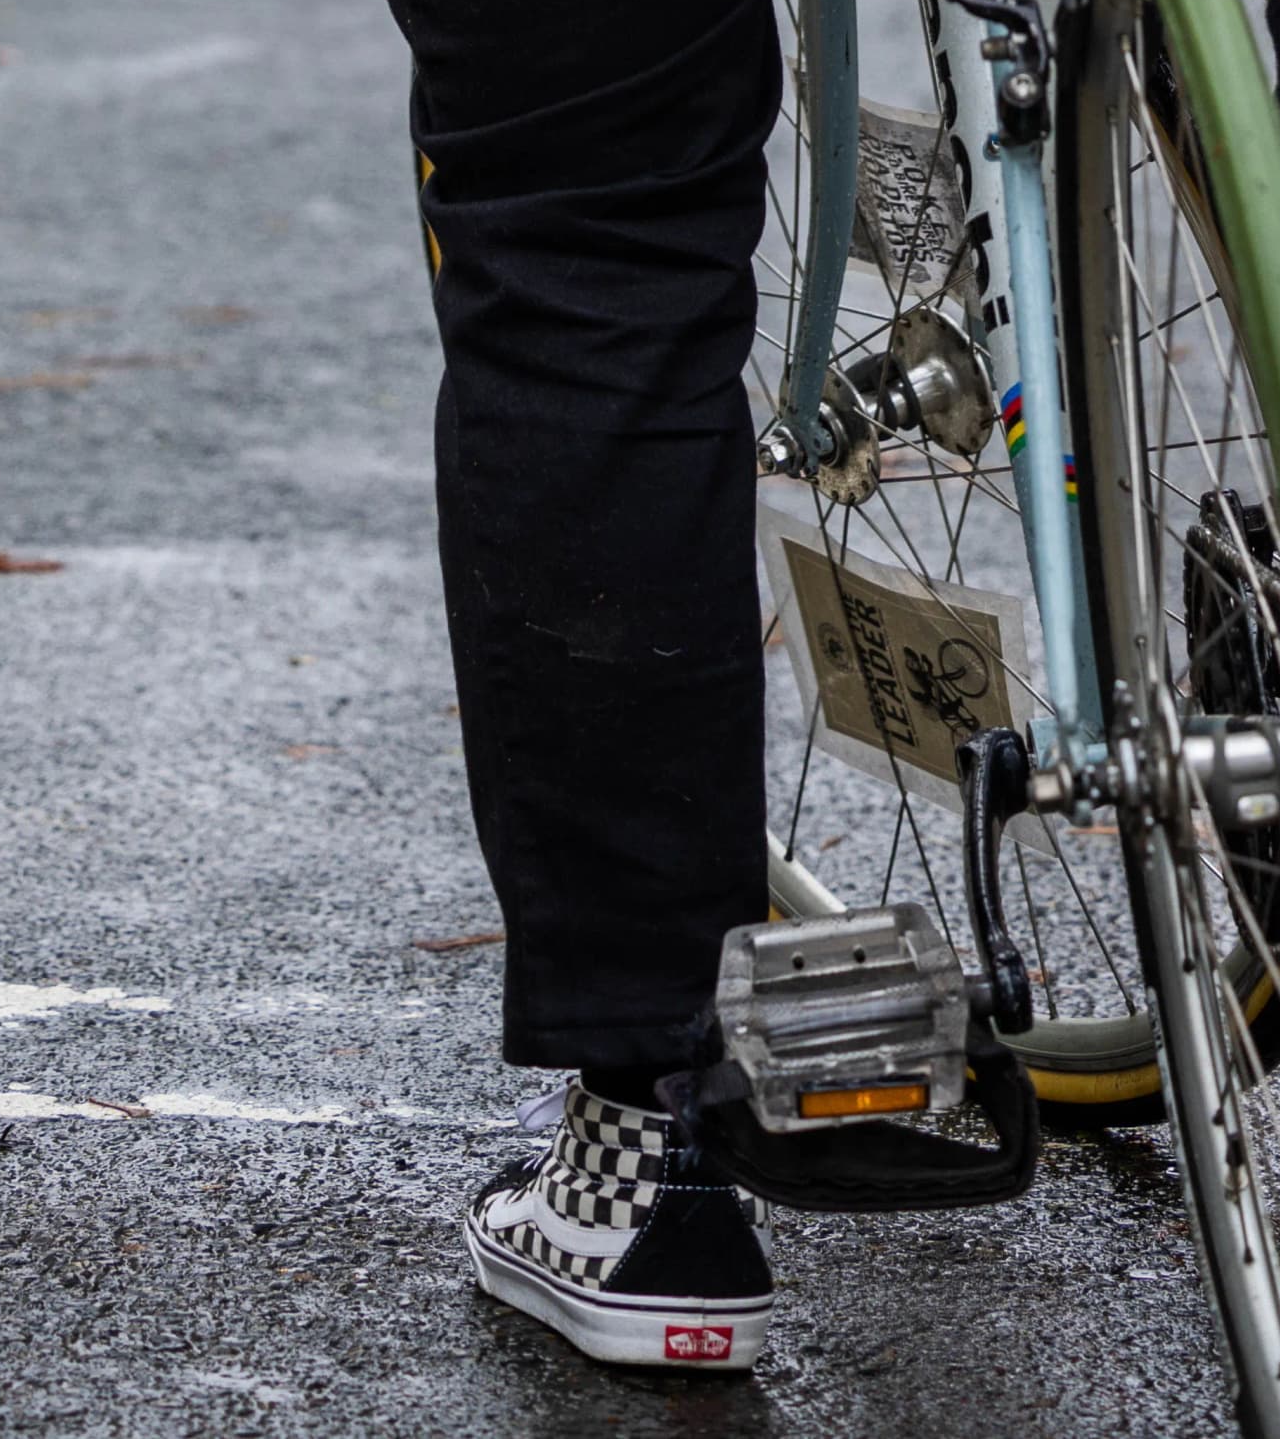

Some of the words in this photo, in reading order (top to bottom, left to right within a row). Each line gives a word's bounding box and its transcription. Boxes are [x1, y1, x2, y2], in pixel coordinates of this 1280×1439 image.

[881, 185, 910, 214] DE
[897, 223, 933, 262] LOS
[895, 172, 918, 202] BIKE
[855, 598, 917, 748] LEADER
